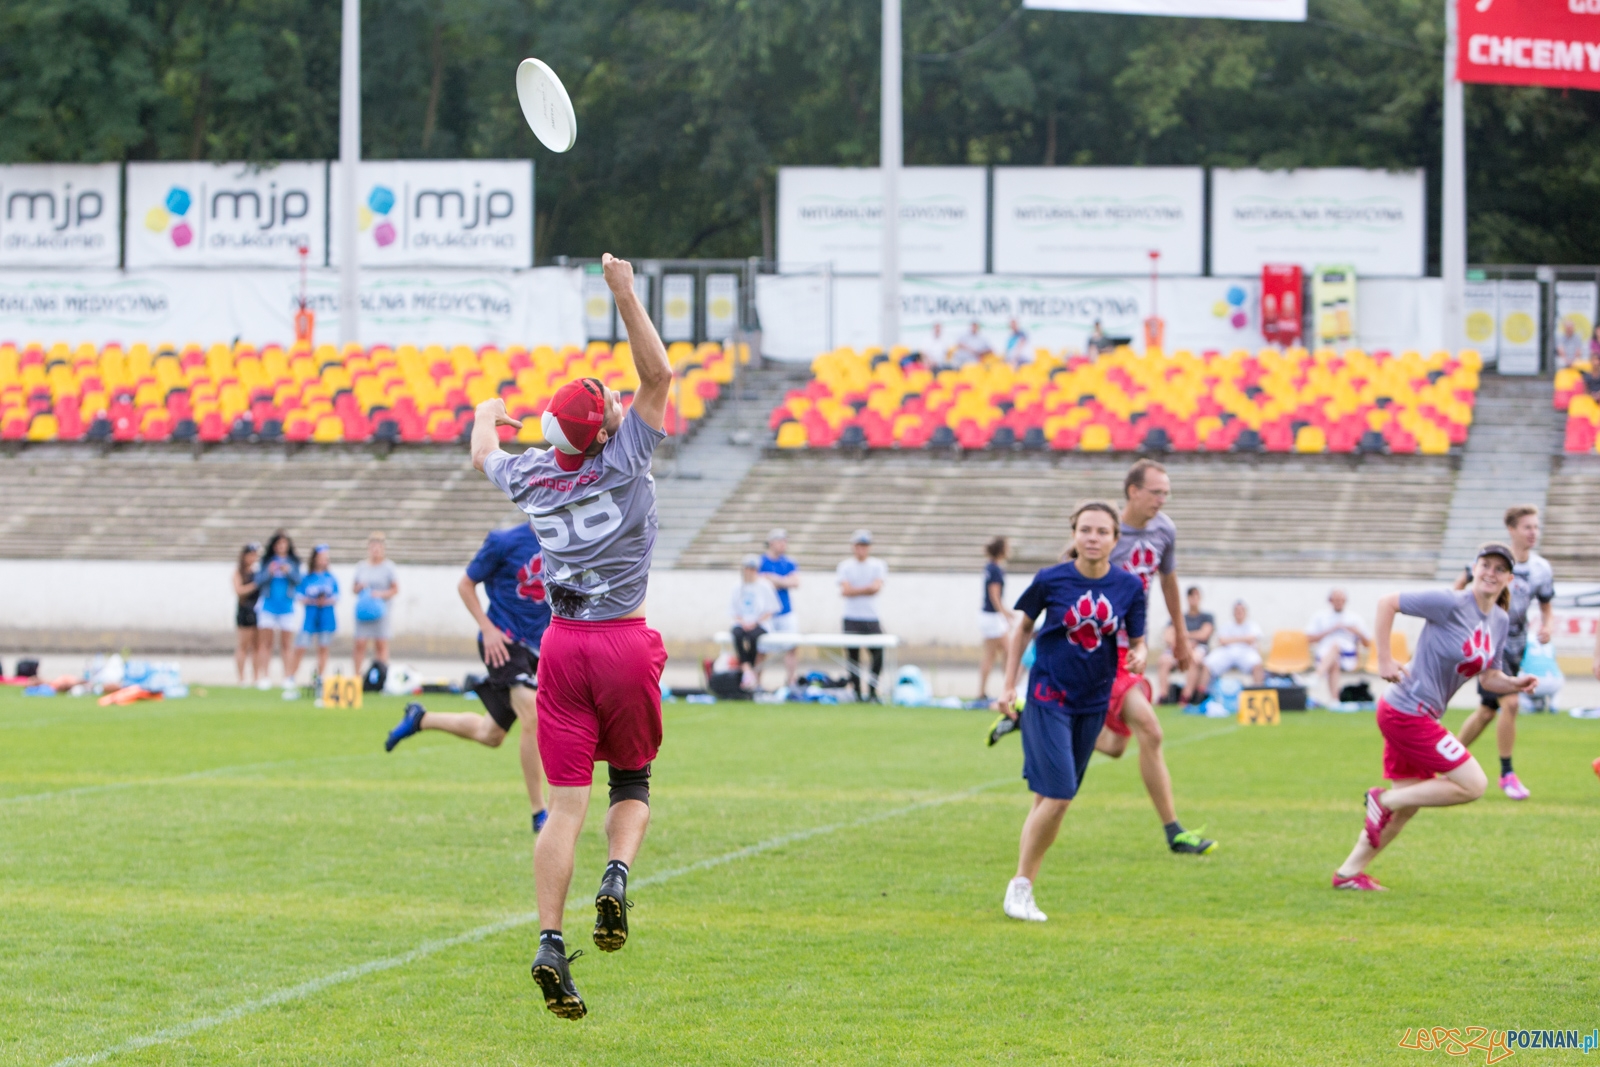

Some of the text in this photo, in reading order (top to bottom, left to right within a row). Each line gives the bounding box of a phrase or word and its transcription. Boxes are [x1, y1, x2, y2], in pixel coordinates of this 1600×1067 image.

[1468, 34, 1600, 72] CHCEMY
[7, 182, 104, 231] mjp
[212, 182, 310, 231] mjp
[415, 181, 515, 230] mjp
[523, 490, 622, 552] 58
[330, 681, 357, 708] 40
[1247, 696, 1274, 723] 50
[1436, 731, 1467, 762] 8
